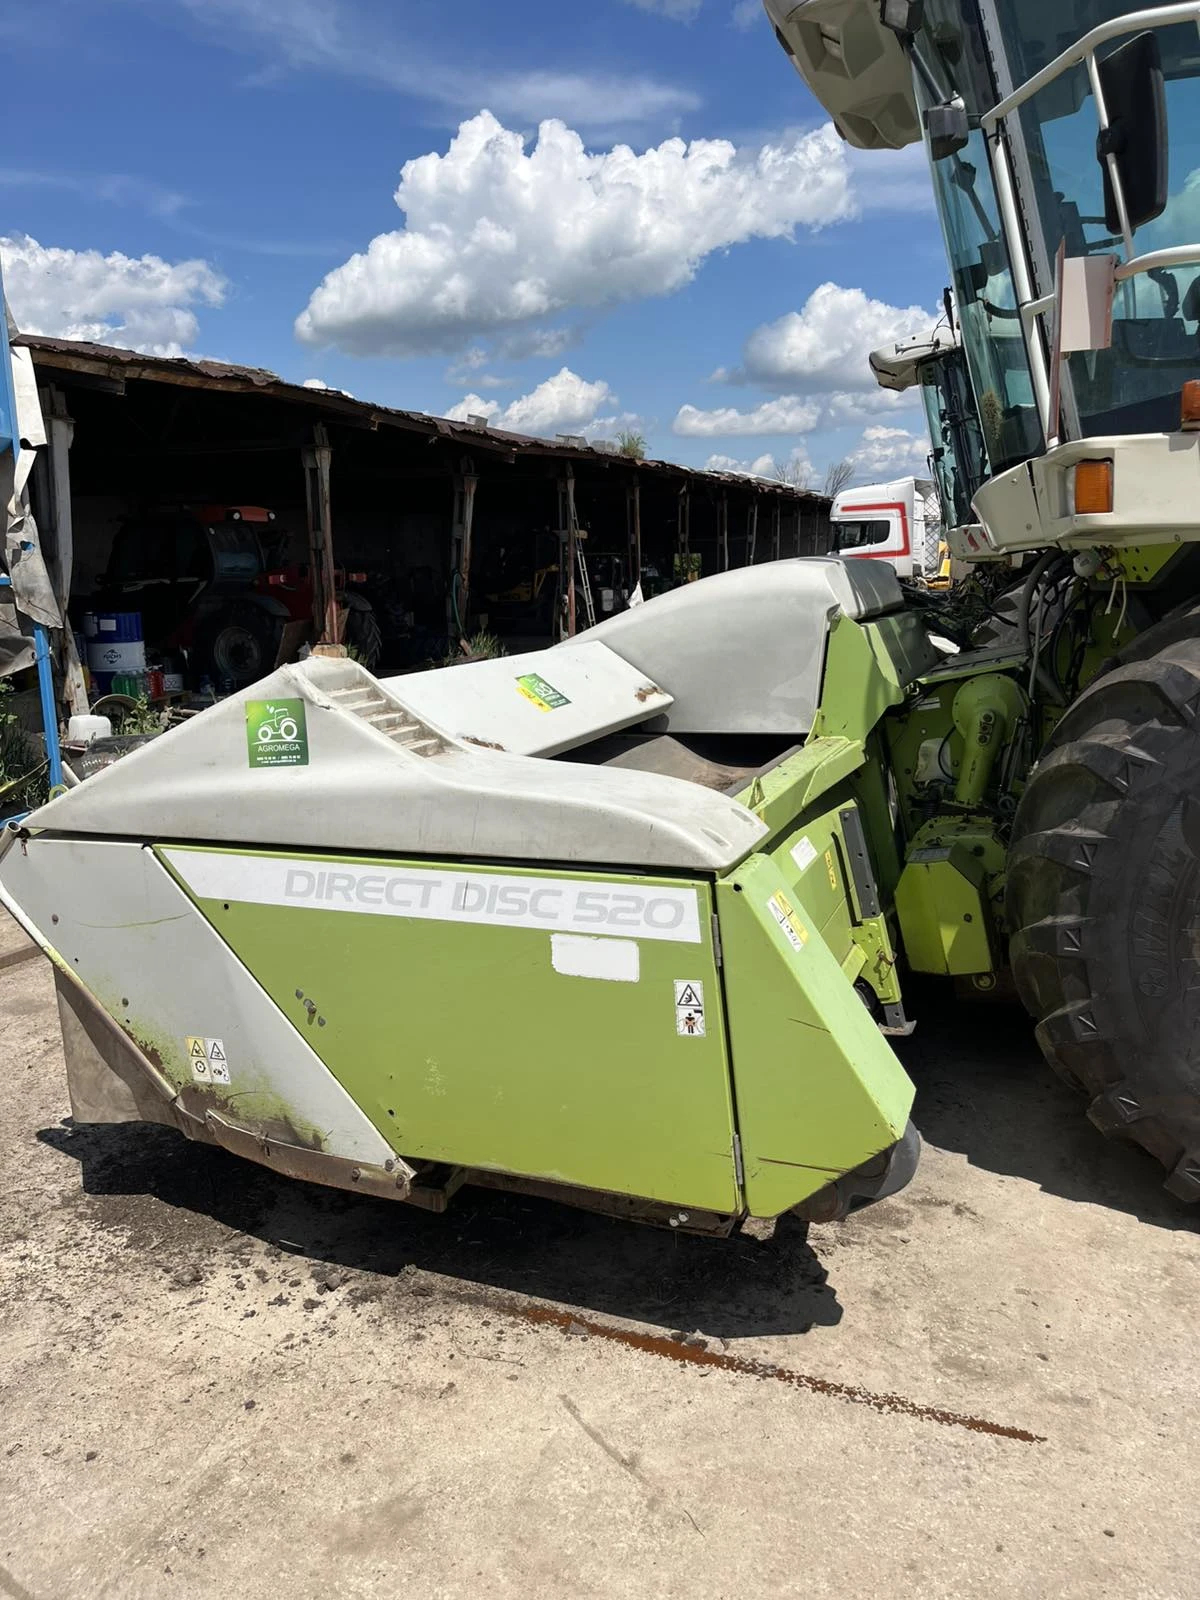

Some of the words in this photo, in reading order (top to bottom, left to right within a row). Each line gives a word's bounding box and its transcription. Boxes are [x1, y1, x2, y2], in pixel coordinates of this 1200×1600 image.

[257, 744, 300, 752] AGROMEGA
[284, 869, 442, 908] DIRECT
[451, 881, 563, 919] DISC
[572, 891, 685, 929] 520
